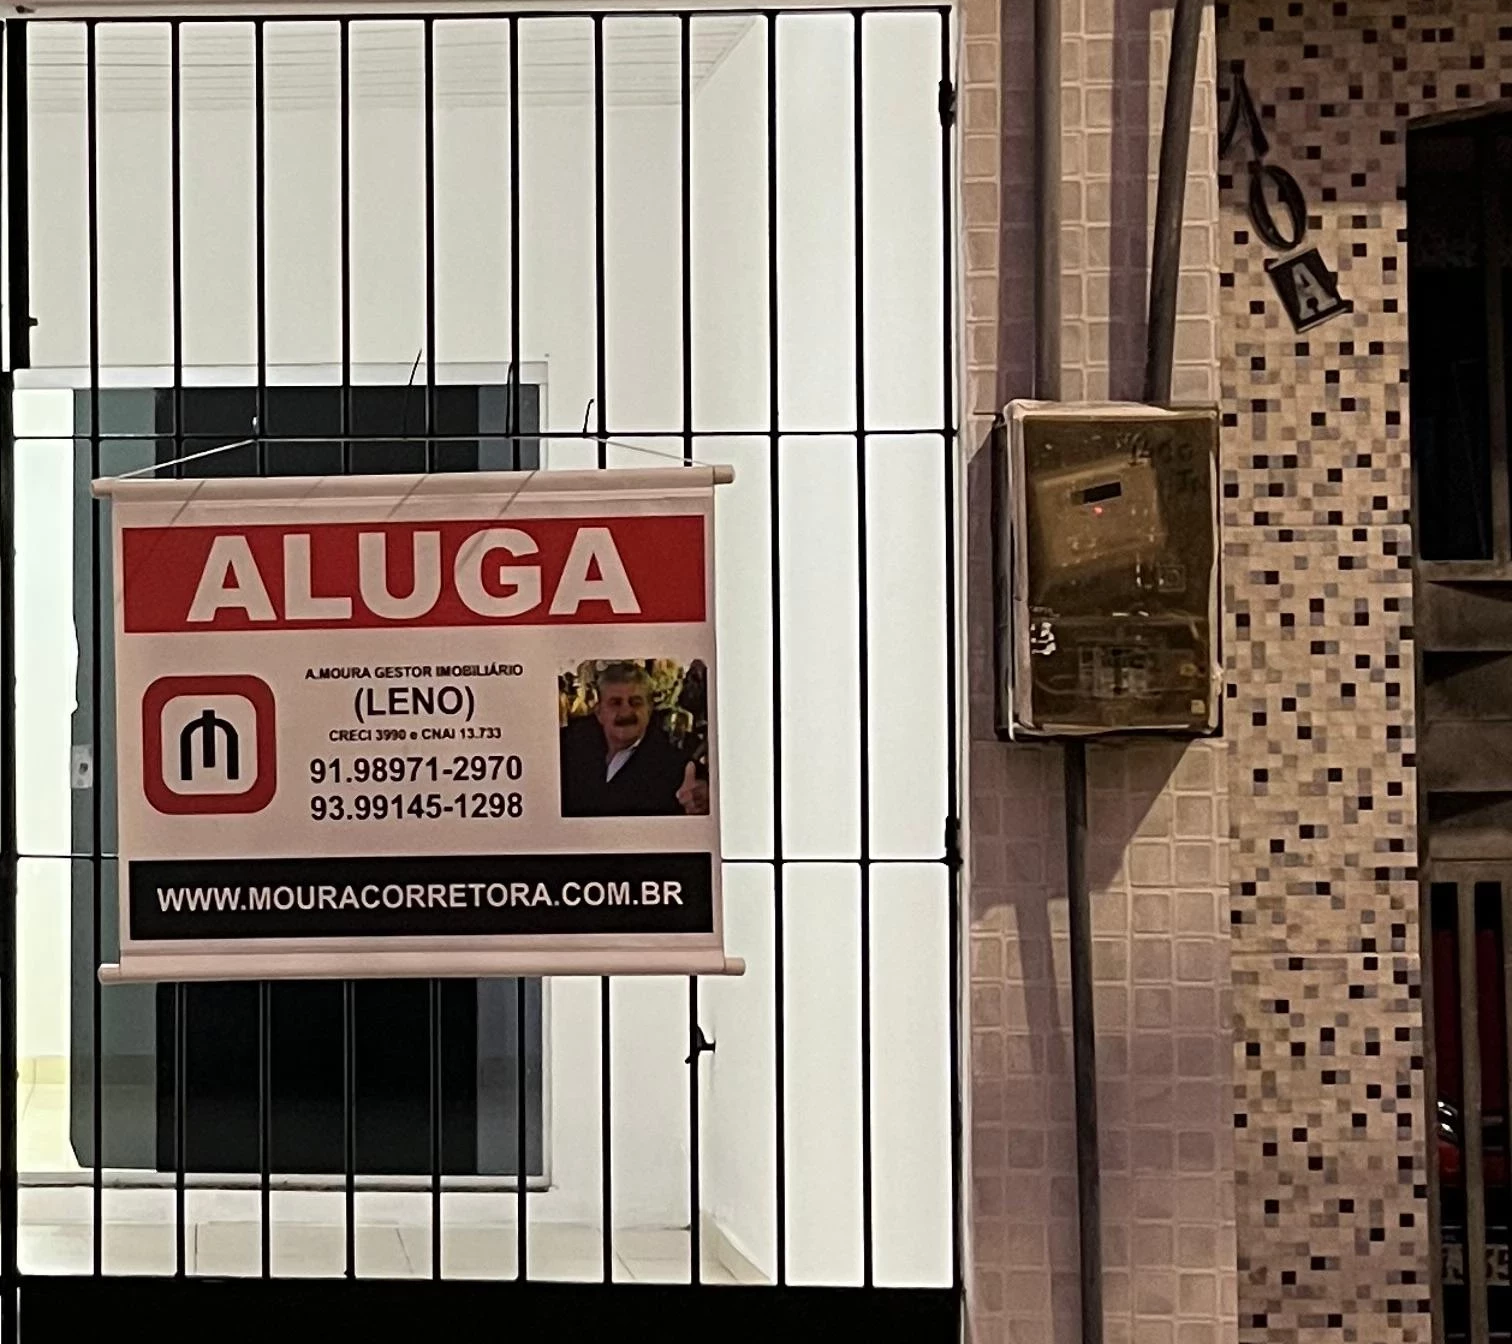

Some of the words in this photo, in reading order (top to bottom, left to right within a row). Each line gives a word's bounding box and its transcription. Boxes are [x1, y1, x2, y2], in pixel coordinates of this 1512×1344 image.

[186, 527, 642, 622] ALUGA
[304, 666, 372, 680] A.MOURA
[374, 665, 432, 679] GESTOR
[435, 662, 524, 677] IMOBILIÁRIO
[354, 685, 475, 724] (LENO)
[329, 729, 372, 742] CRECI
[375, 729, 407, 741] 3990
[409, 731, 418, 740] e
[421, 728, 456, 740] CNAI
[460, 726, 502, 739] 13.733
[310, 755, 524, 784] 91.98971-2970
[310, 792, 524, 821] 93.99145-1298
[157, 881, 684, 912] WWW.MOURACORRETORA.COM.BR
